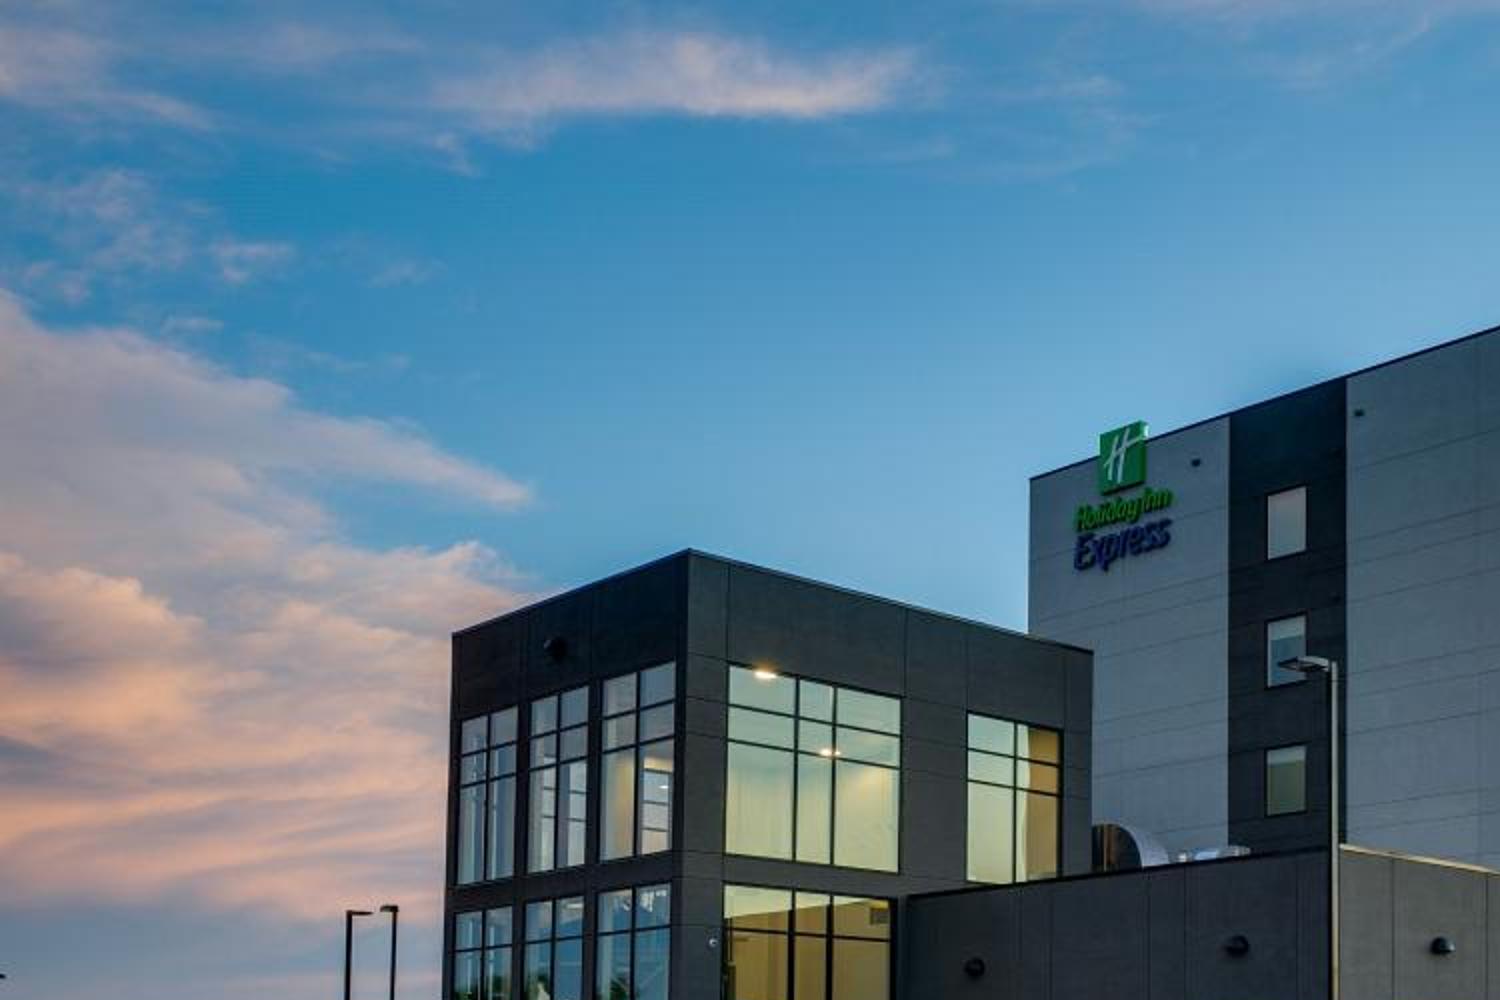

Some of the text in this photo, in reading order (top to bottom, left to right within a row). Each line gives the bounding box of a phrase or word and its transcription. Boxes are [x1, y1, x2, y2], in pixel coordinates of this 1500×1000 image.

[1076, 488, 1173, 532] Holiday Inn
[1074, 518, 1172, 572] Express
